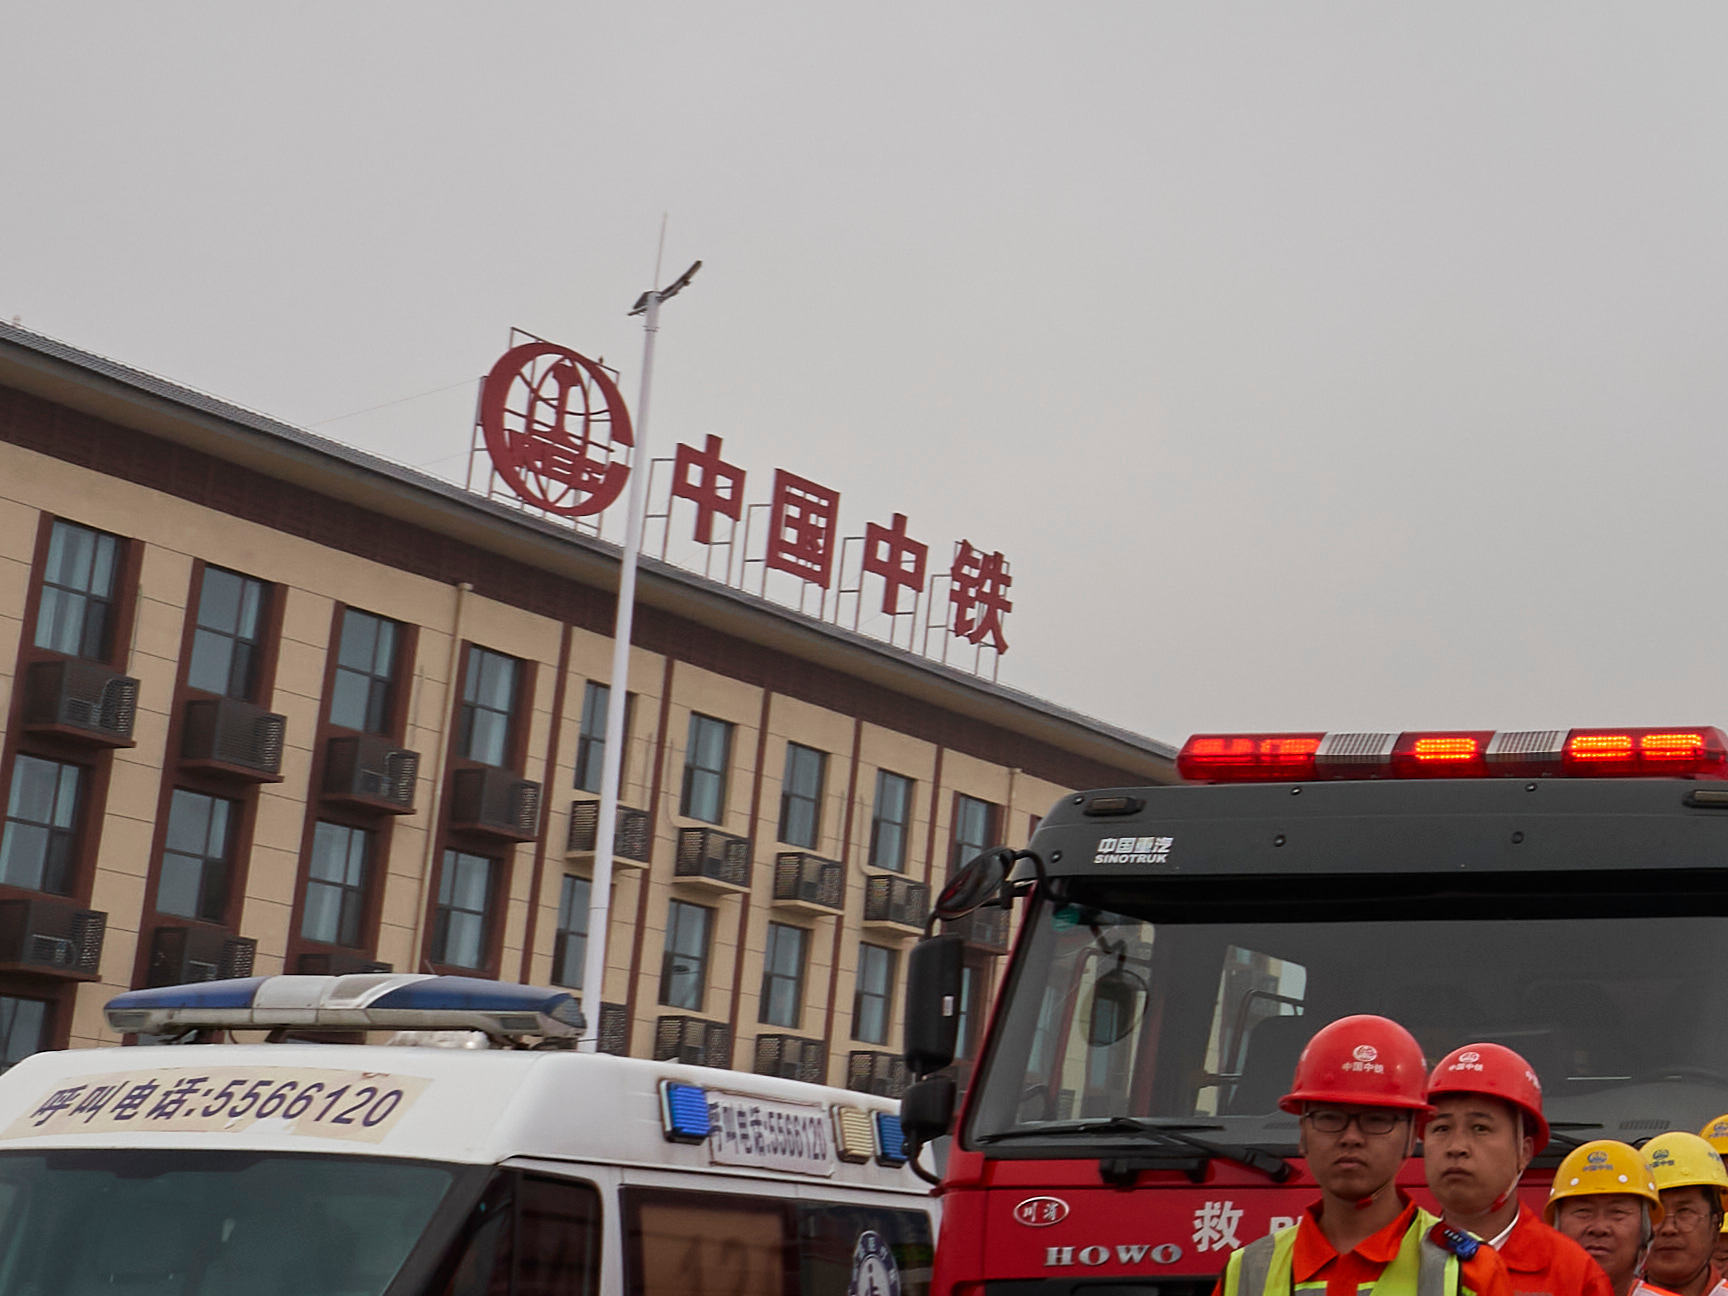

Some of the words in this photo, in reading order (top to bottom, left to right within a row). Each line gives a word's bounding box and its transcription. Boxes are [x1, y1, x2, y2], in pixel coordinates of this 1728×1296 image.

[672, 432, 1013, 656] 中国中铁
[1097, 837, 1174, 853] 中国重汽
[1094, 854, 1168, 863] SINOTRUK
[1192, 1201, 1244, 1253] 救
[1045, 1243, 1183, 1267] HOWO
